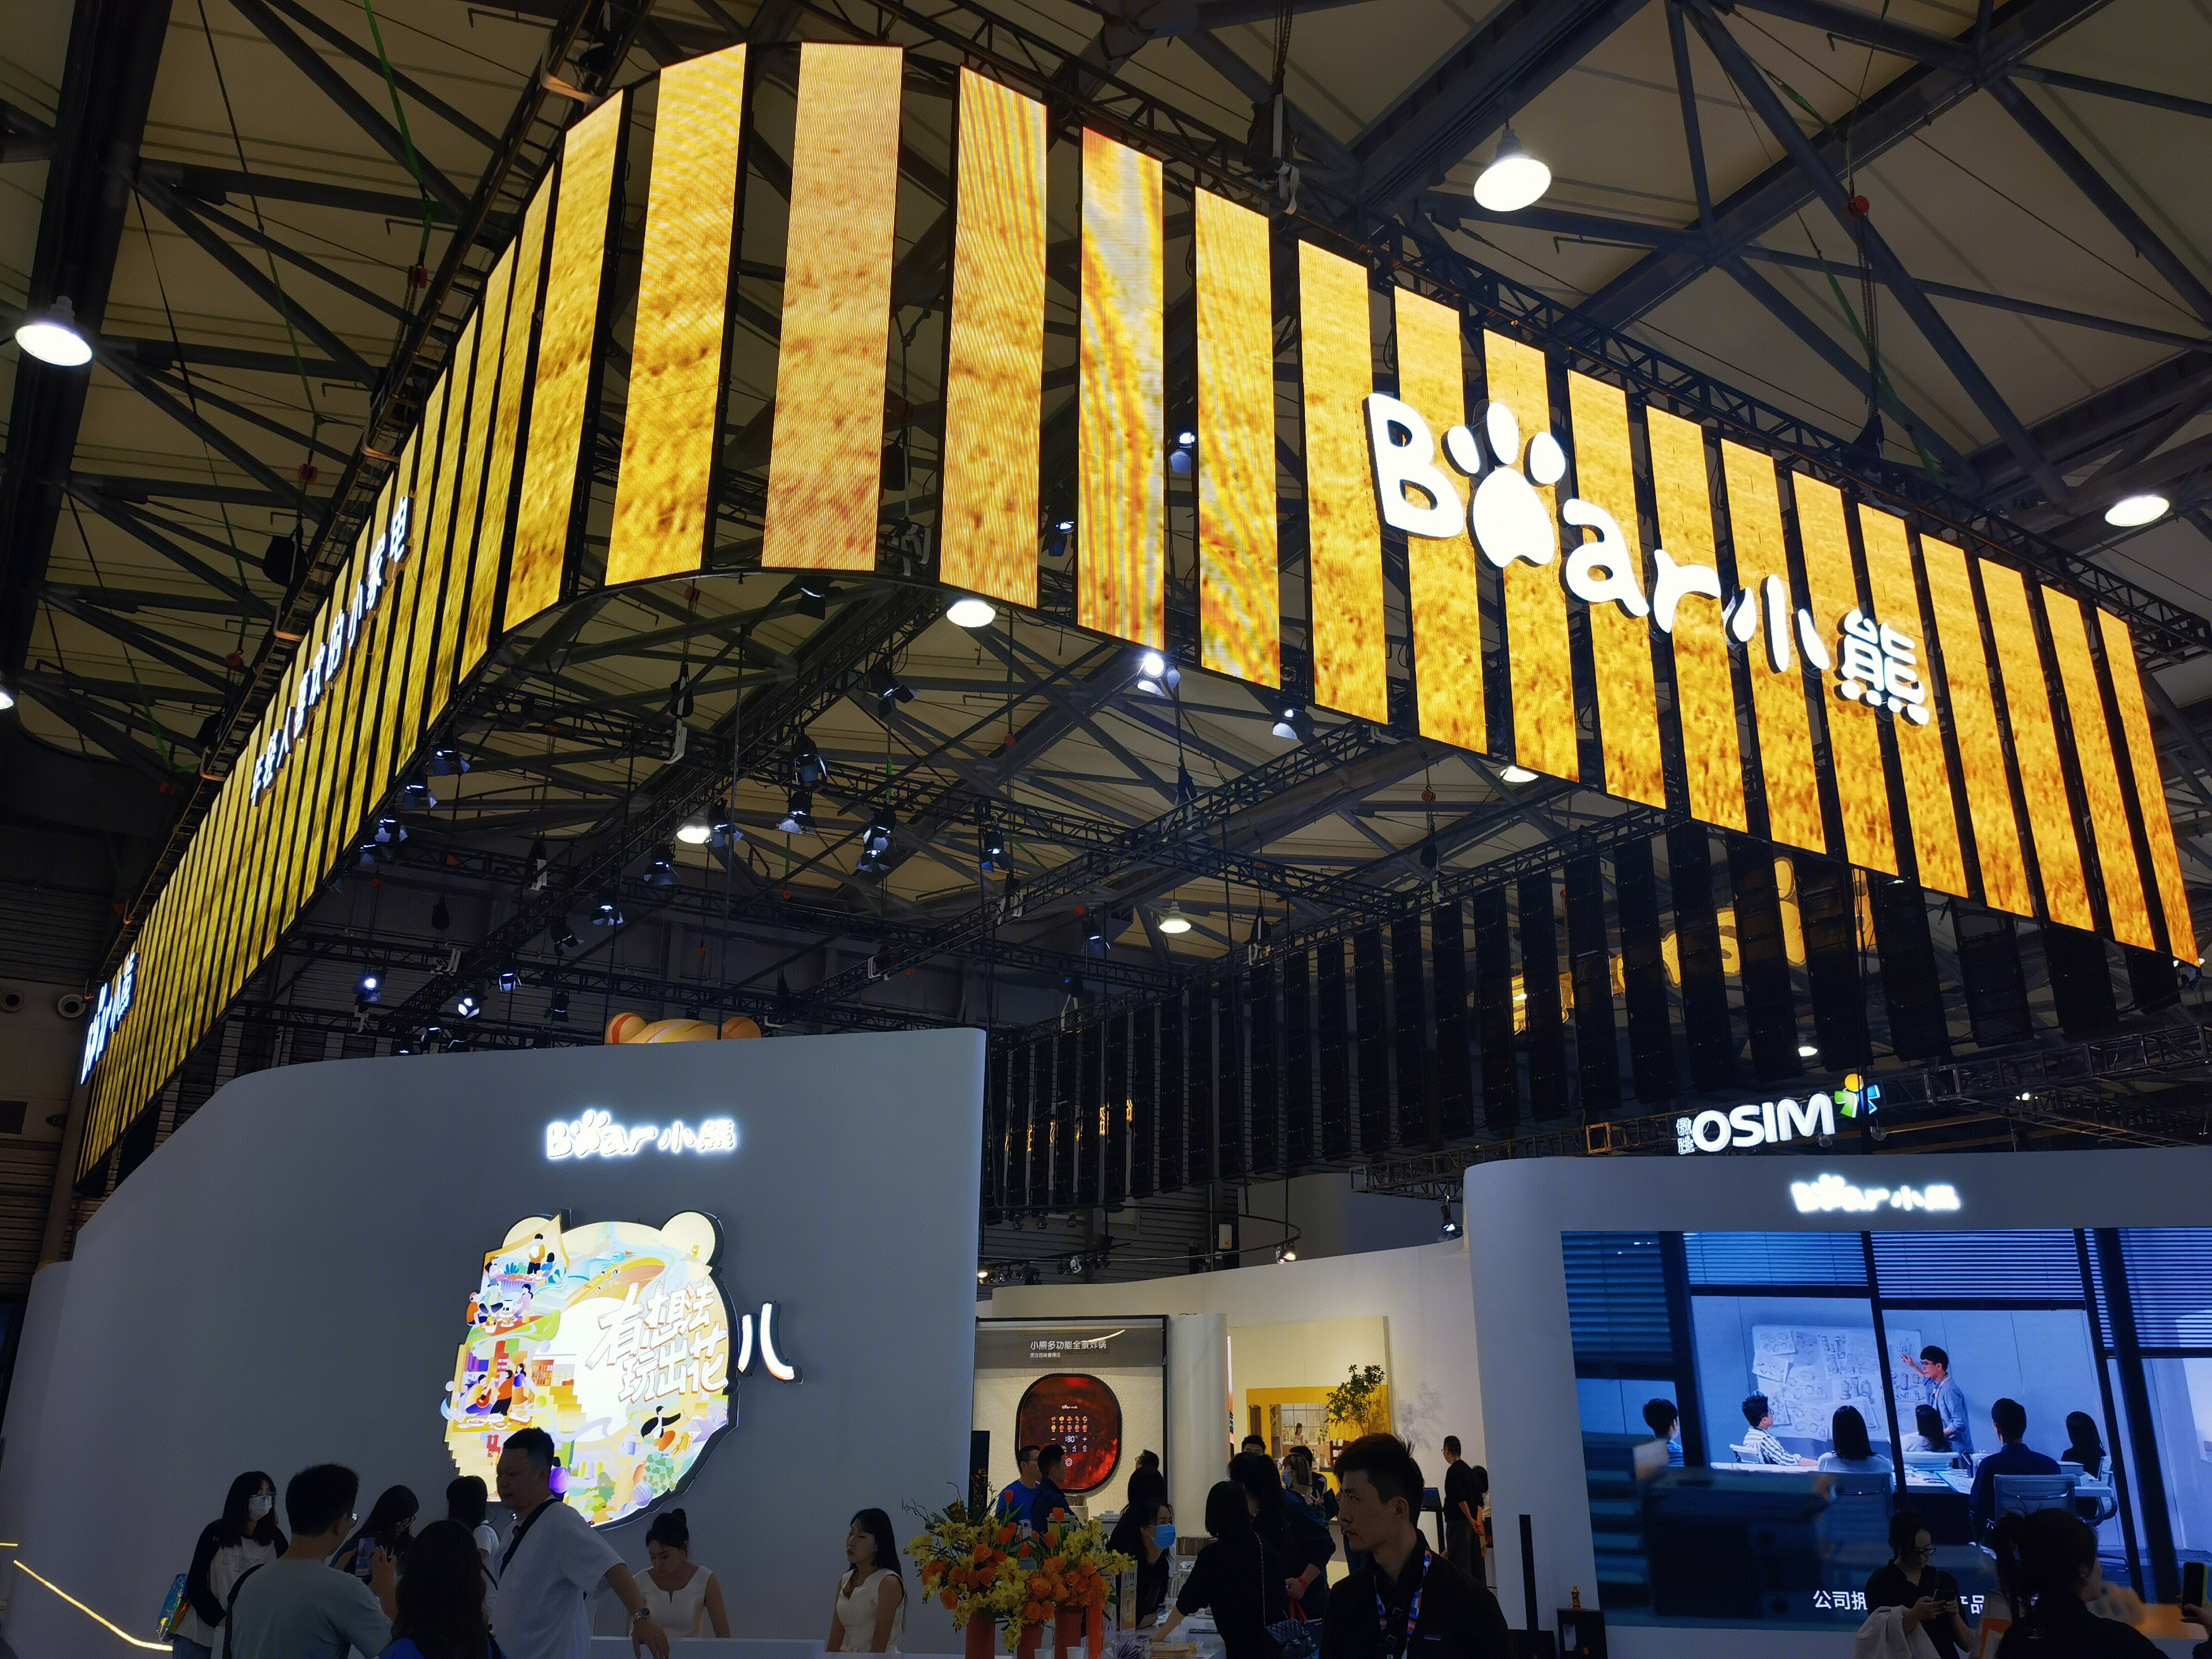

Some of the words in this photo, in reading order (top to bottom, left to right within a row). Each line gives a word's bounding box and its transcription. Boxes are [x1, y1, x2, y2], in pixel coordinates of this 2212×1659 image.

[1731, 574, 1930, 725] 小熊
[657, 1120, 735, 1152] 小熊
[1691, 1093, 1836, 1152] OSIM
[585, 1275, 714, 1371] 有想法
[1030, 1340, 1107, 1350] 小熊多功能全景炸锅
